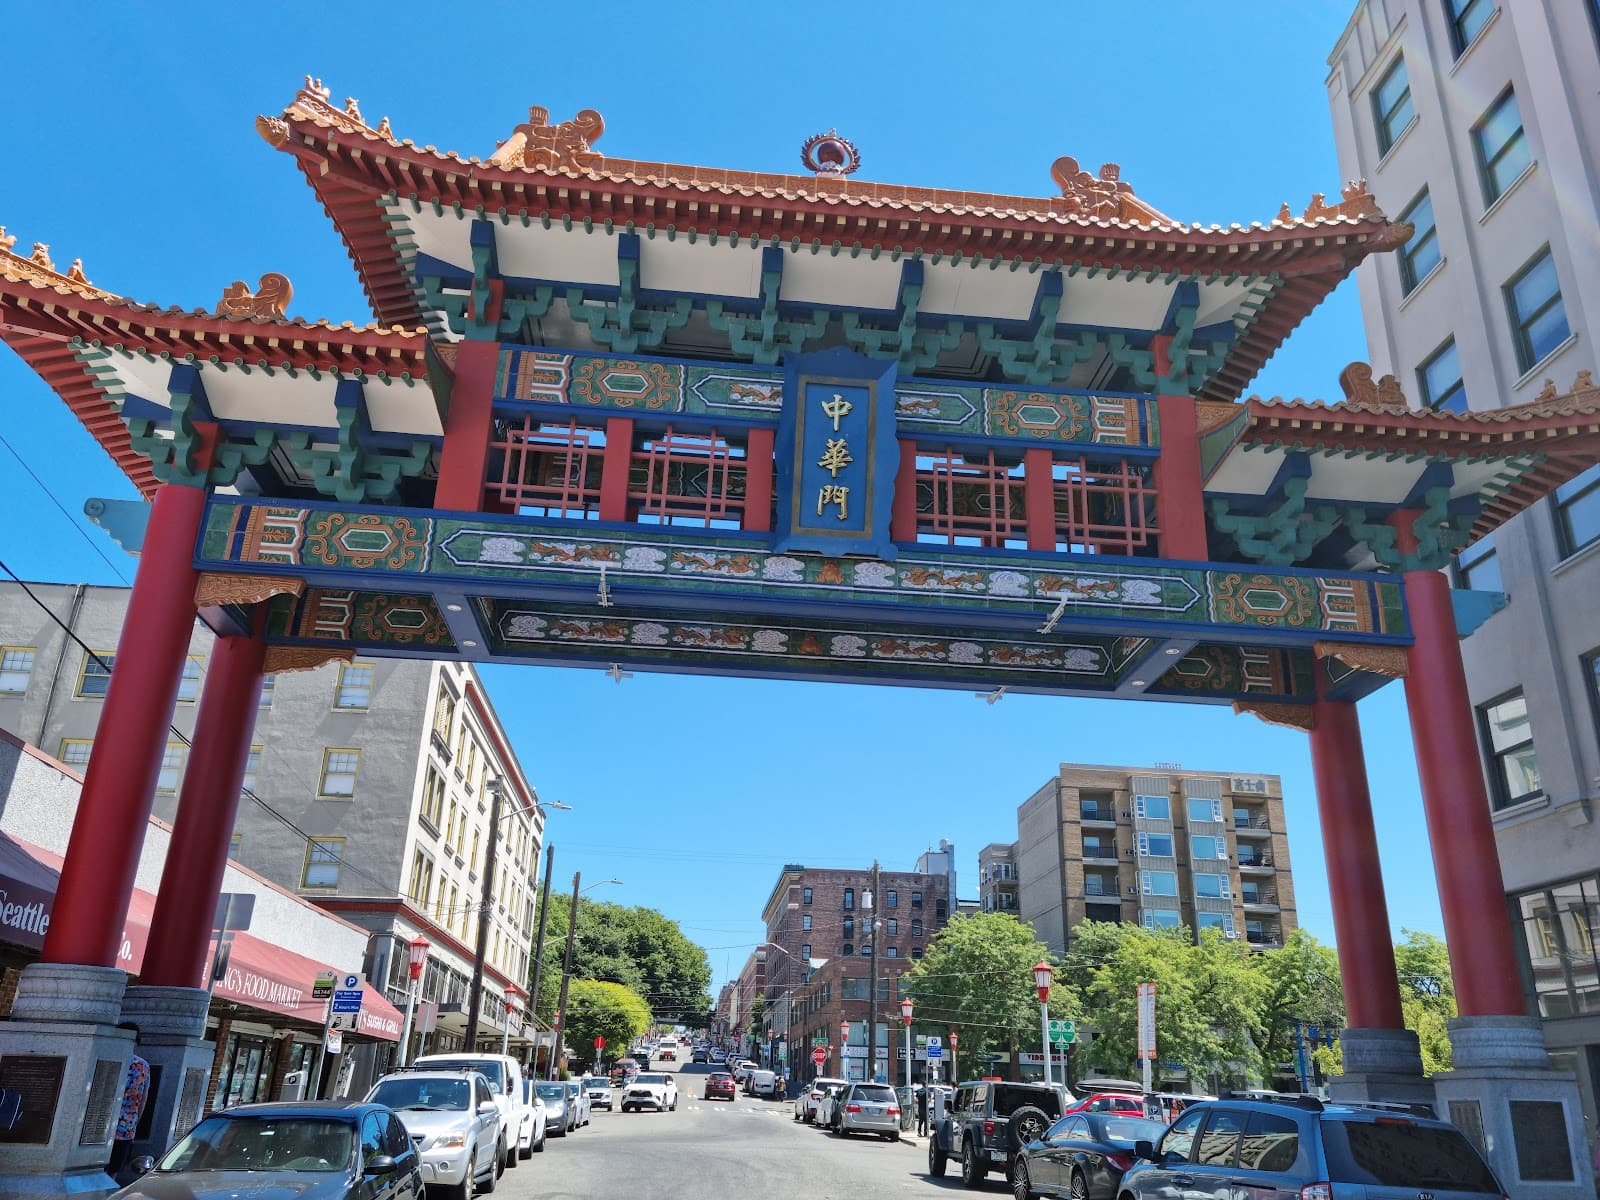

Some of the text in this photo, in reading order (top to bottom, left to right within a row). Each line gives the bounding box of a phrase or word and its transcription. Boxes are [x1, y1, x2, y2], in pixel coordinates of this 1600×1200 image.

[816, 393, 854, 520] 中華門
[242, 973, 269, 1000] FOOD
[268, 981, 303, 1009] MARKET
[366, 1014, 382, 1030] SUSHI
[385, 1020, 399, 1034] GRILL
